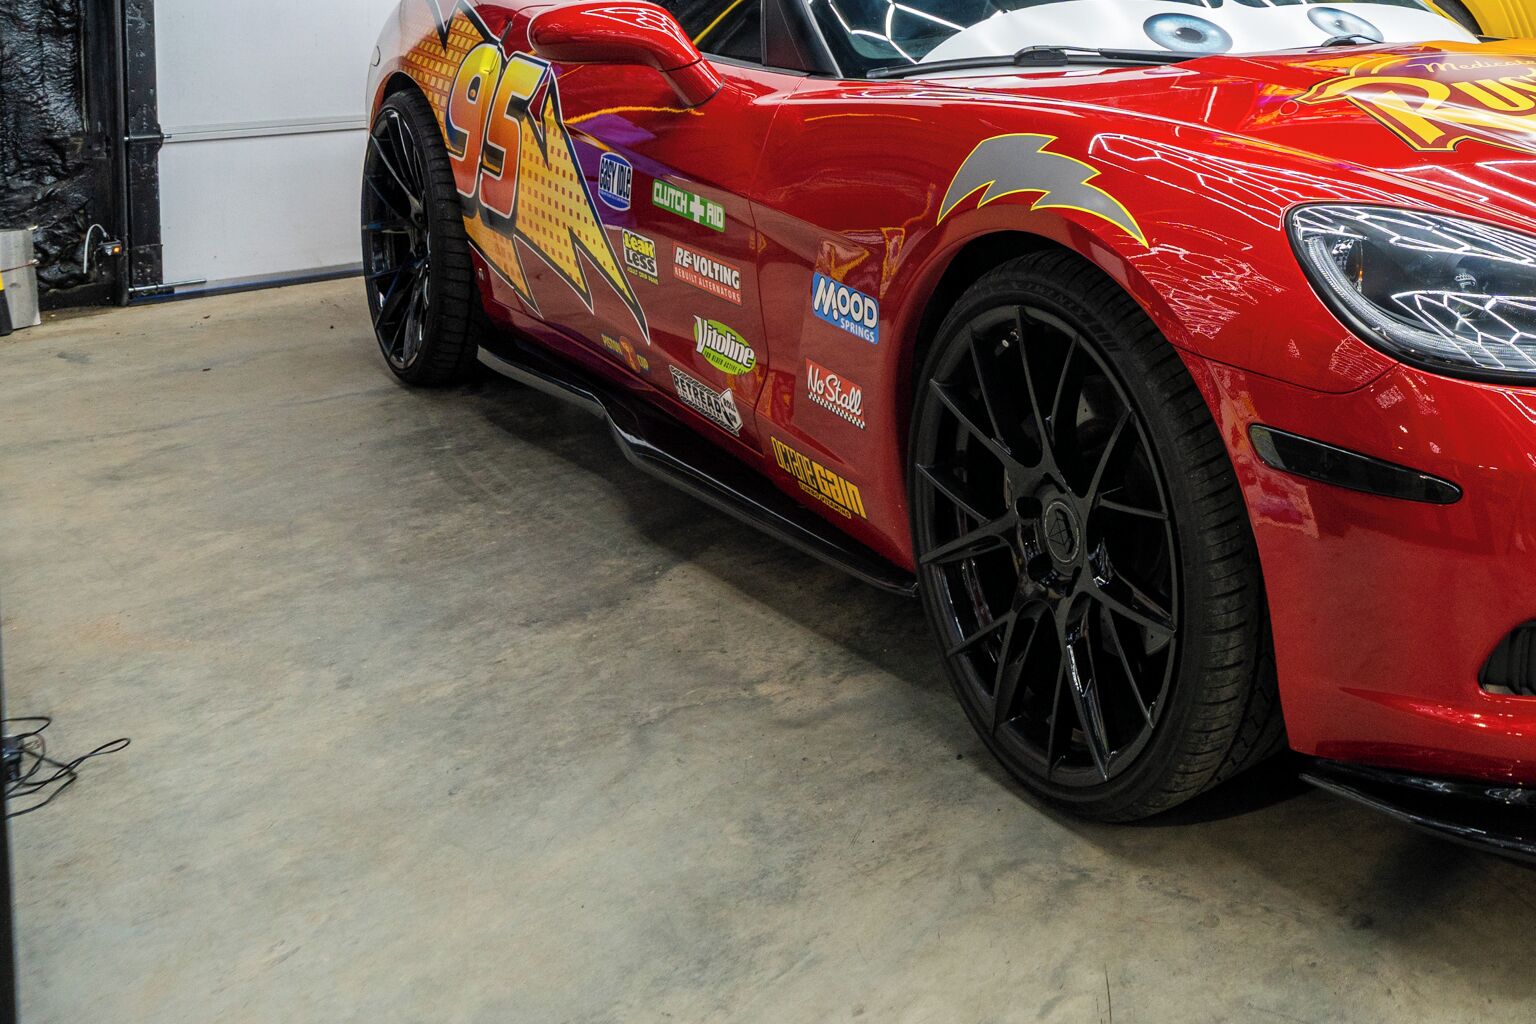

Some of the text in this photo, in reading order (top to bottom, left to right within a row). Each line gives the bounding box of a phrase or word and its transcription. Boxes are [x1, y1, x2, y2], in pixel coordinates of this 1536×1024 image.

[446, 42, 551, 219] 95
[653, 182, 688, 214] CLUTCH
[706, 202, 725, 229] AID
[813, 276, 878, 329] MOOD
[693, 314, 755, 368] Vitoline
[840, 317, 876, 343] SPRINGS
[807, 364, 863, 416] No Stall
